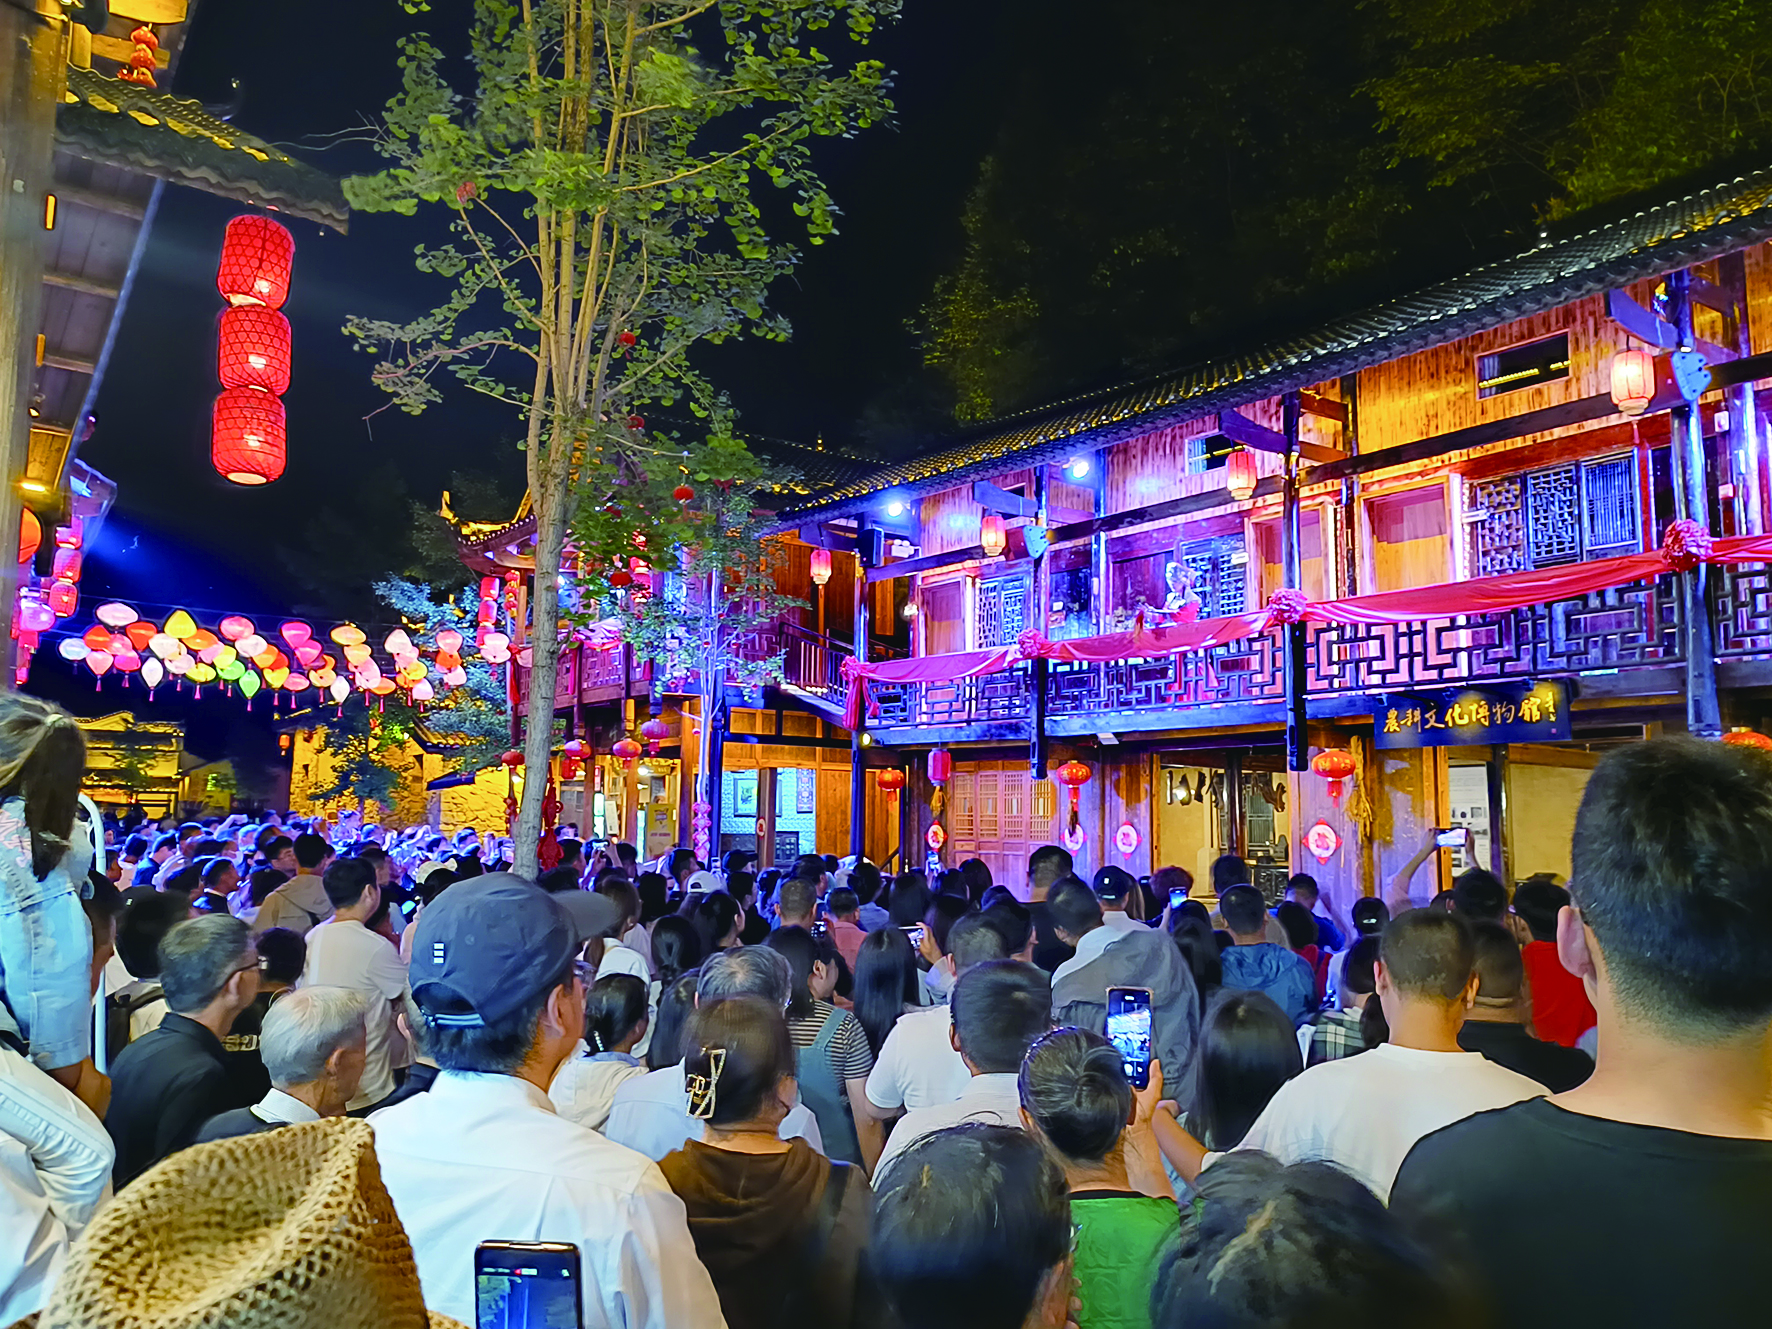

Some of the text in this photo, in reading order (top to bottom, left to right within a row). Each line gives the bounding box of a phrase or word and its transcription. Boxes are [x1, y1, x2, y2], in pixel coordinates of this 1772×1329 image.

[1383, 698, 1541, 733] 農耕文化博物館
